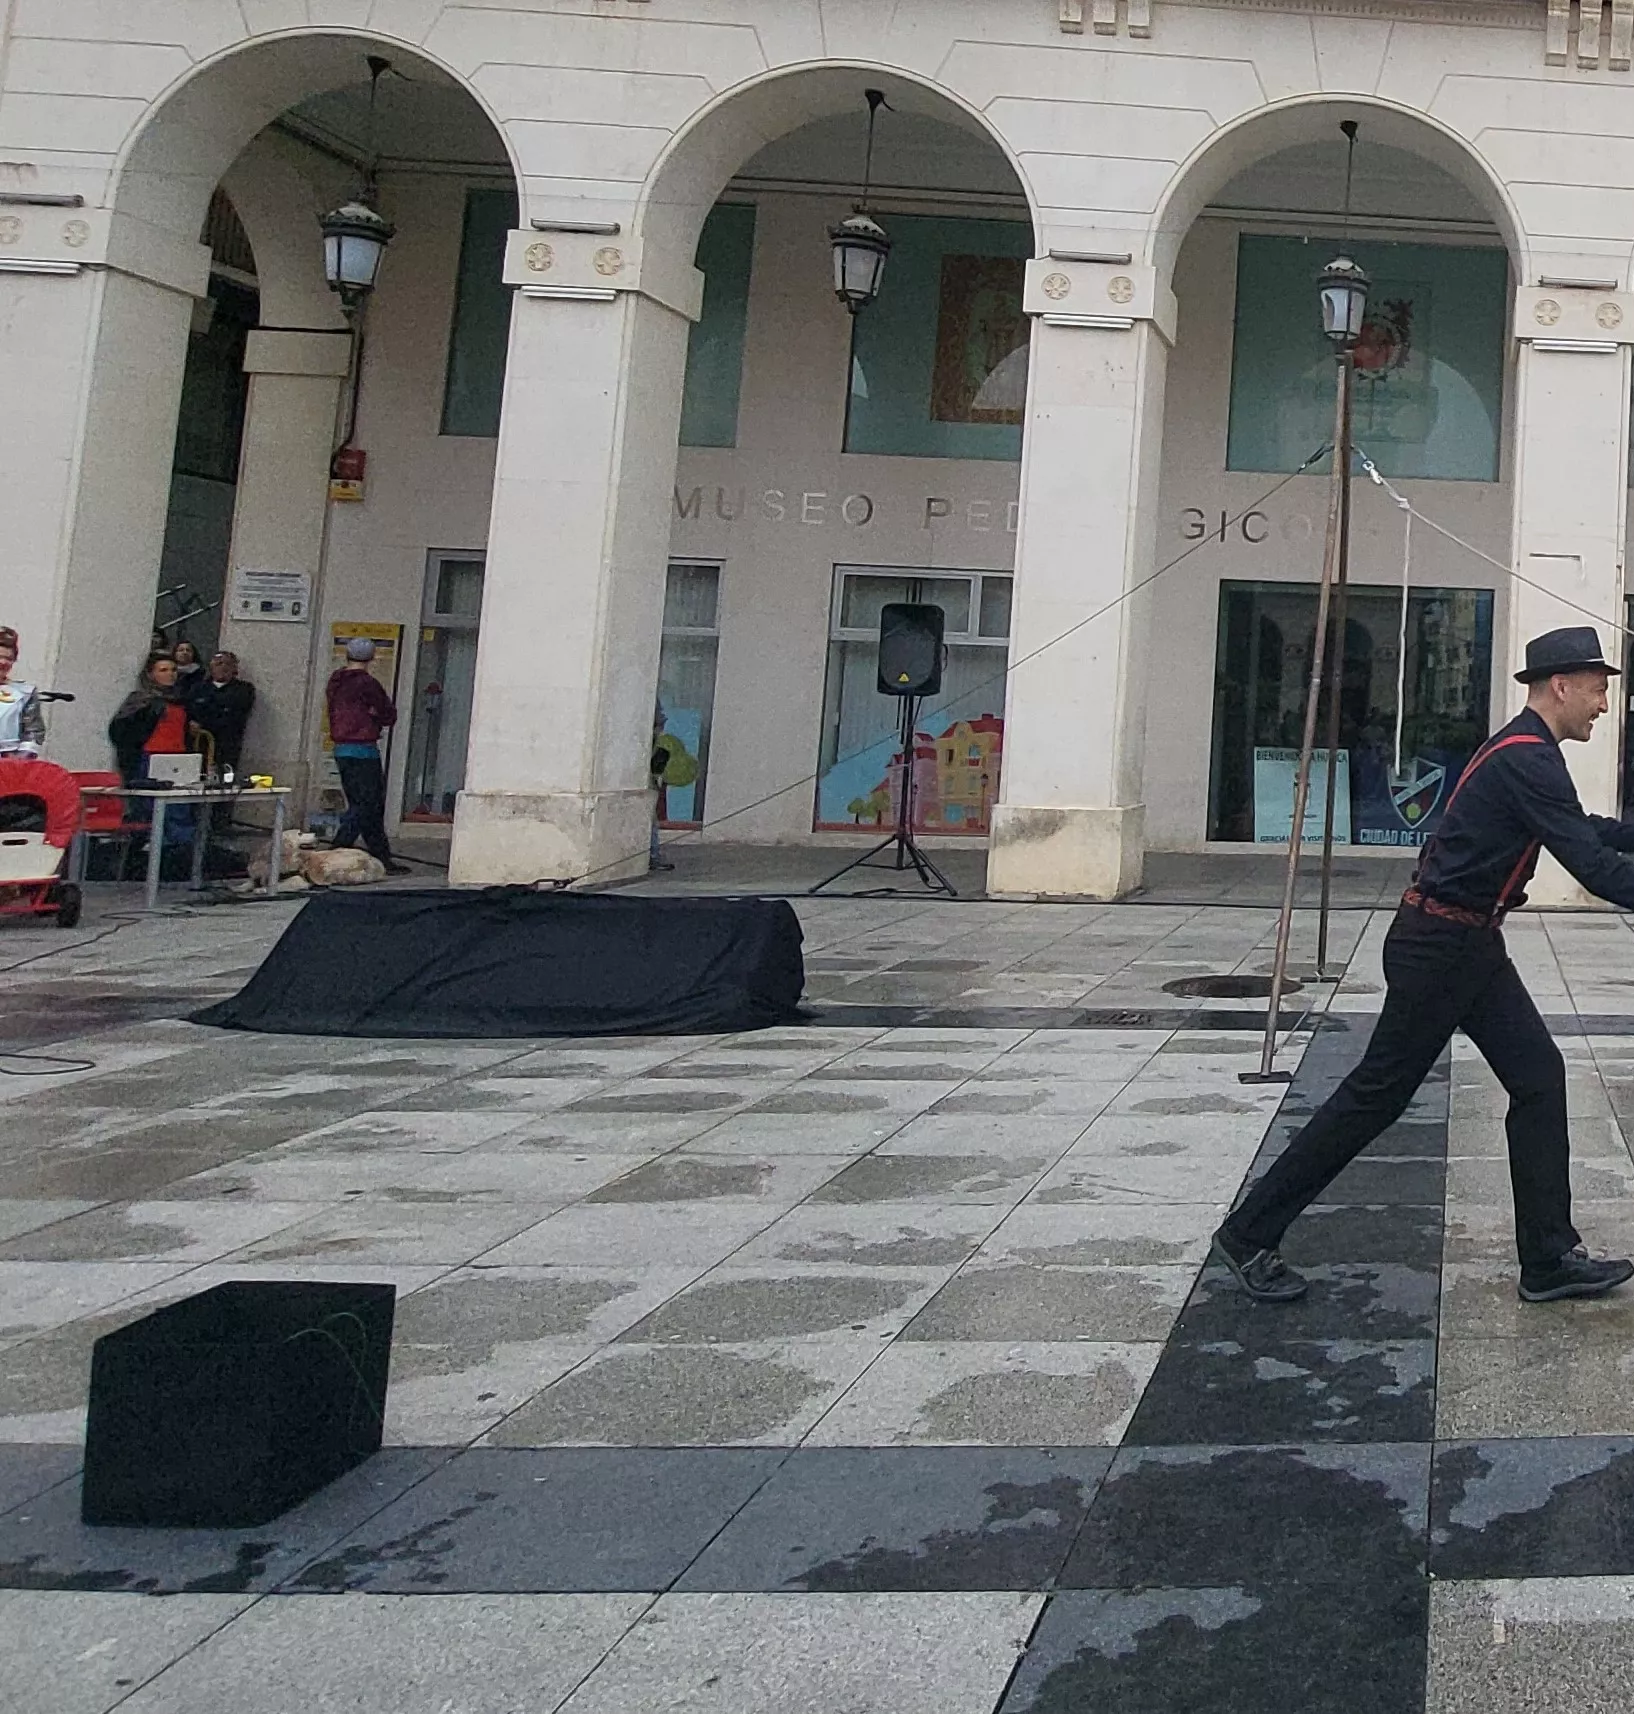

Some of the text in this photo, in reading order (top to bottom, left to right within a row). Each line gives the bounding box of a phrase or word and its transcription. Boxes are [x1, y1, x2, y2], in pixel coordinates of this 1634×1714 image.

[674, 486, 874, 527] MUSEO
[1360, 828, 1399, 845] CIUDAD
[1400, 830, 1415, 846] DE
